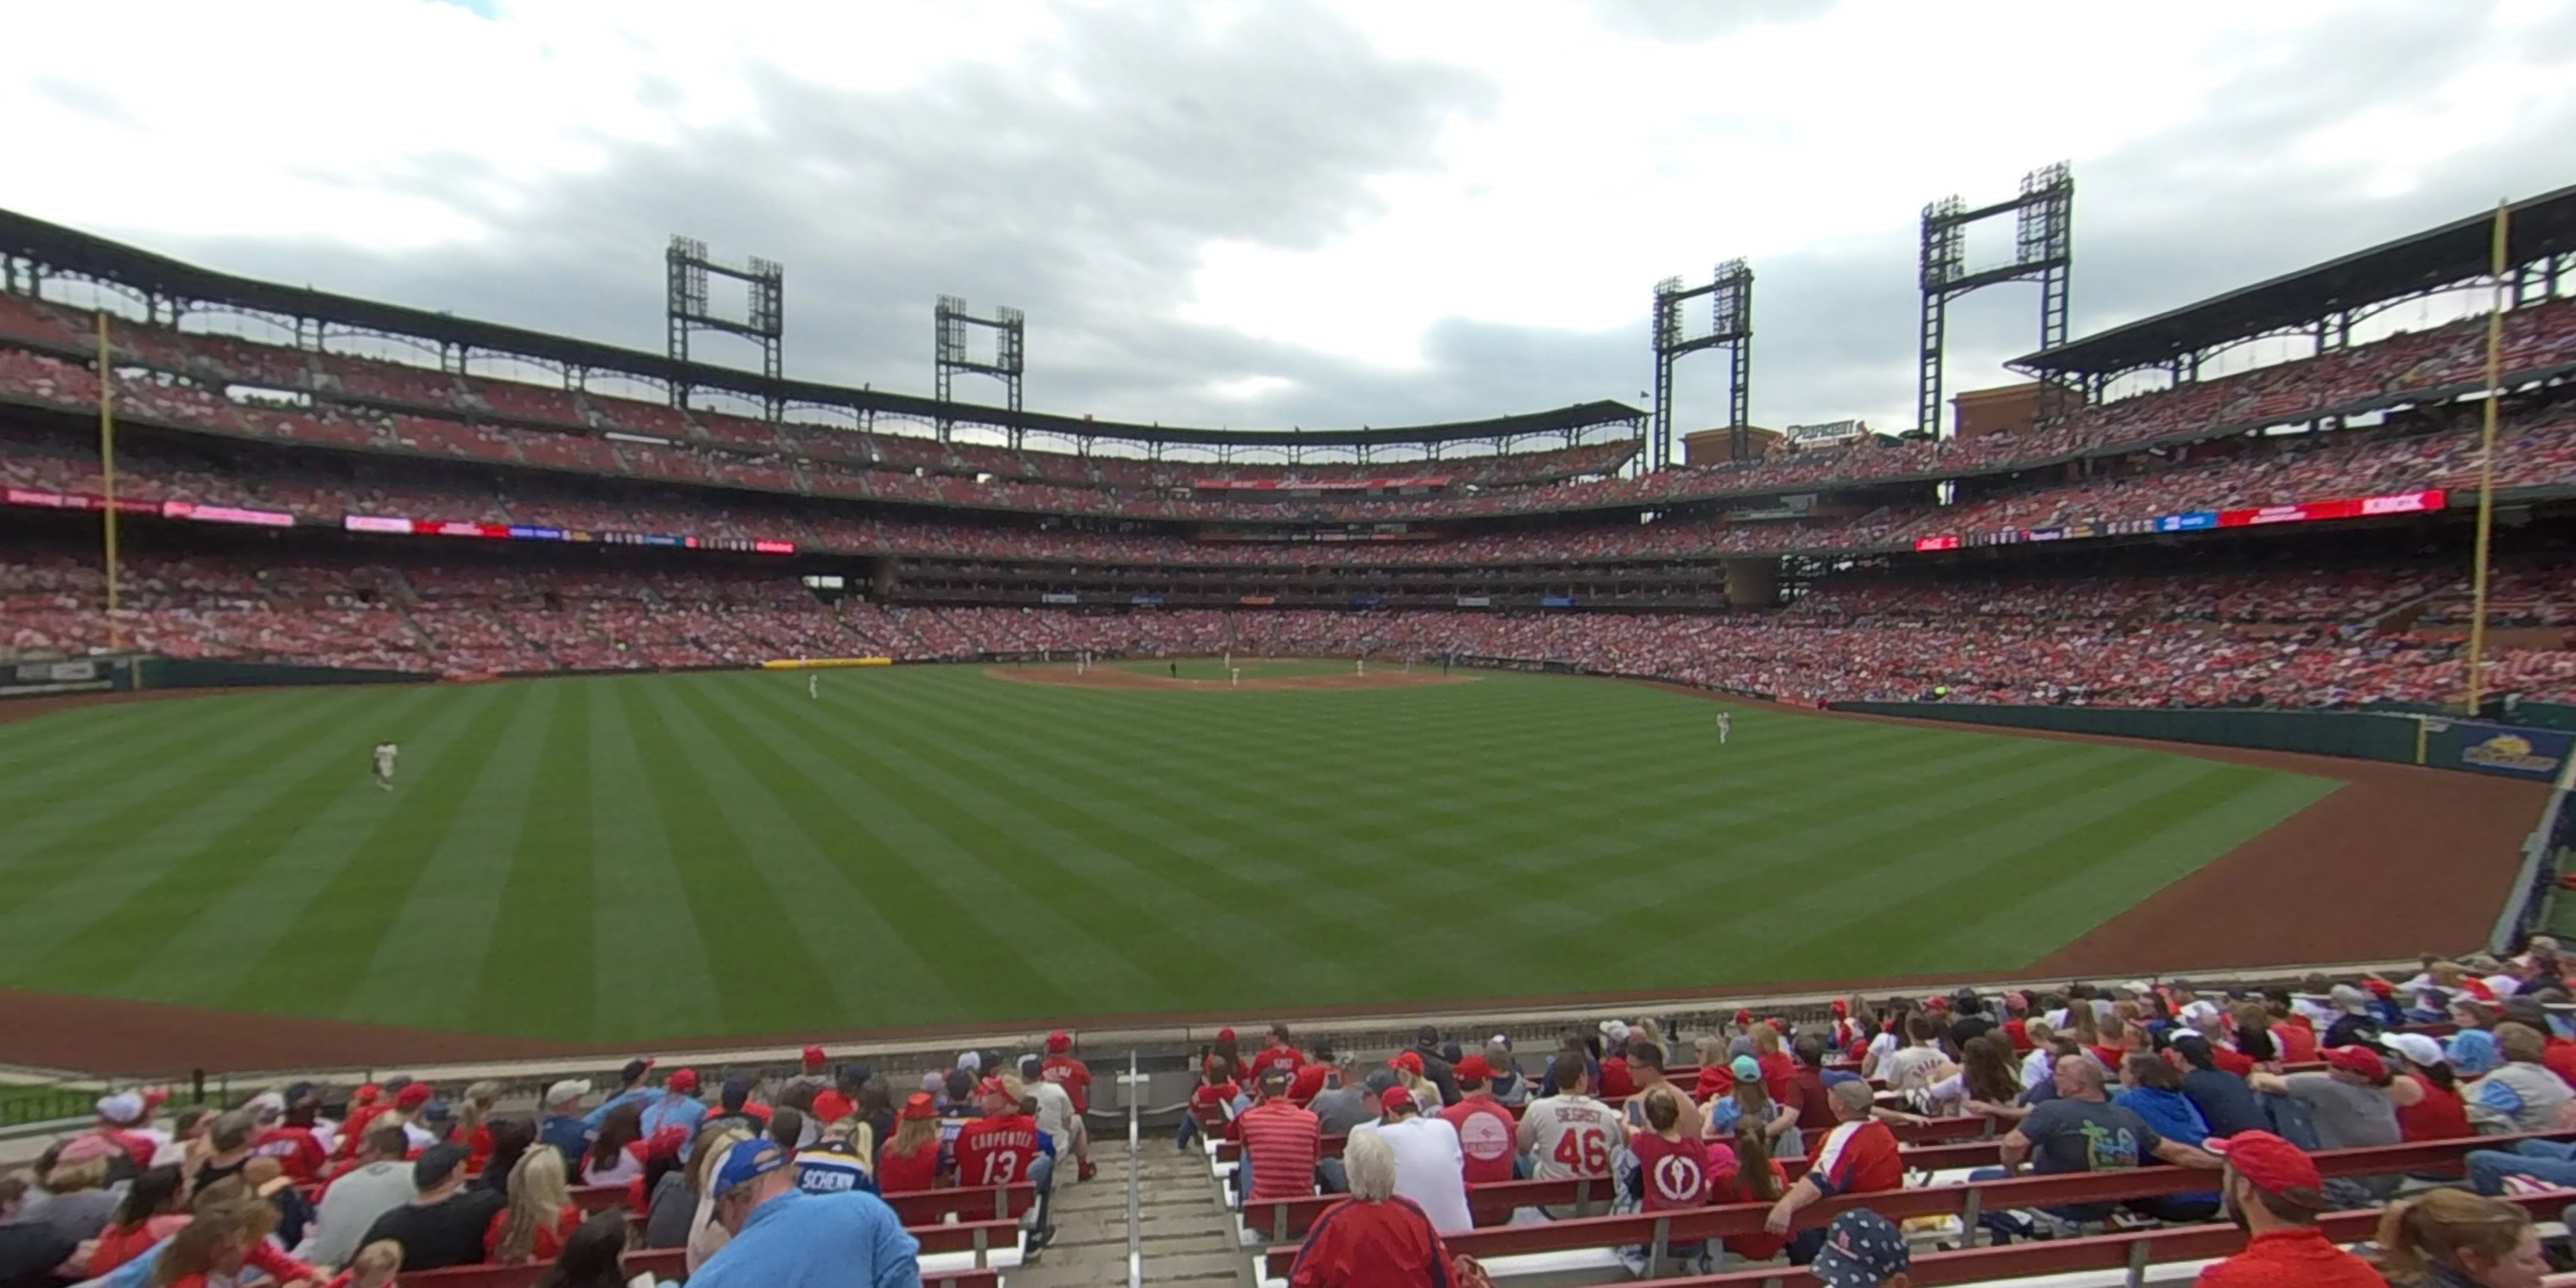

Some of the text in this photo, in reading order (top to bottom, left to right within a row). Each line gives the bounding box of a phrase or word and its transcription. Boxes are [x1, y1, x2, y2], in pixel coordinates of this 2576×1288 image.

[1555, 1107, 1601, 1124] SIEGRIST
[970, 1131, 1033, 1152] CARPENTER
[1554, 1127, 1607, 1175] 46
[981, 1151, 1018, 1185] 13
